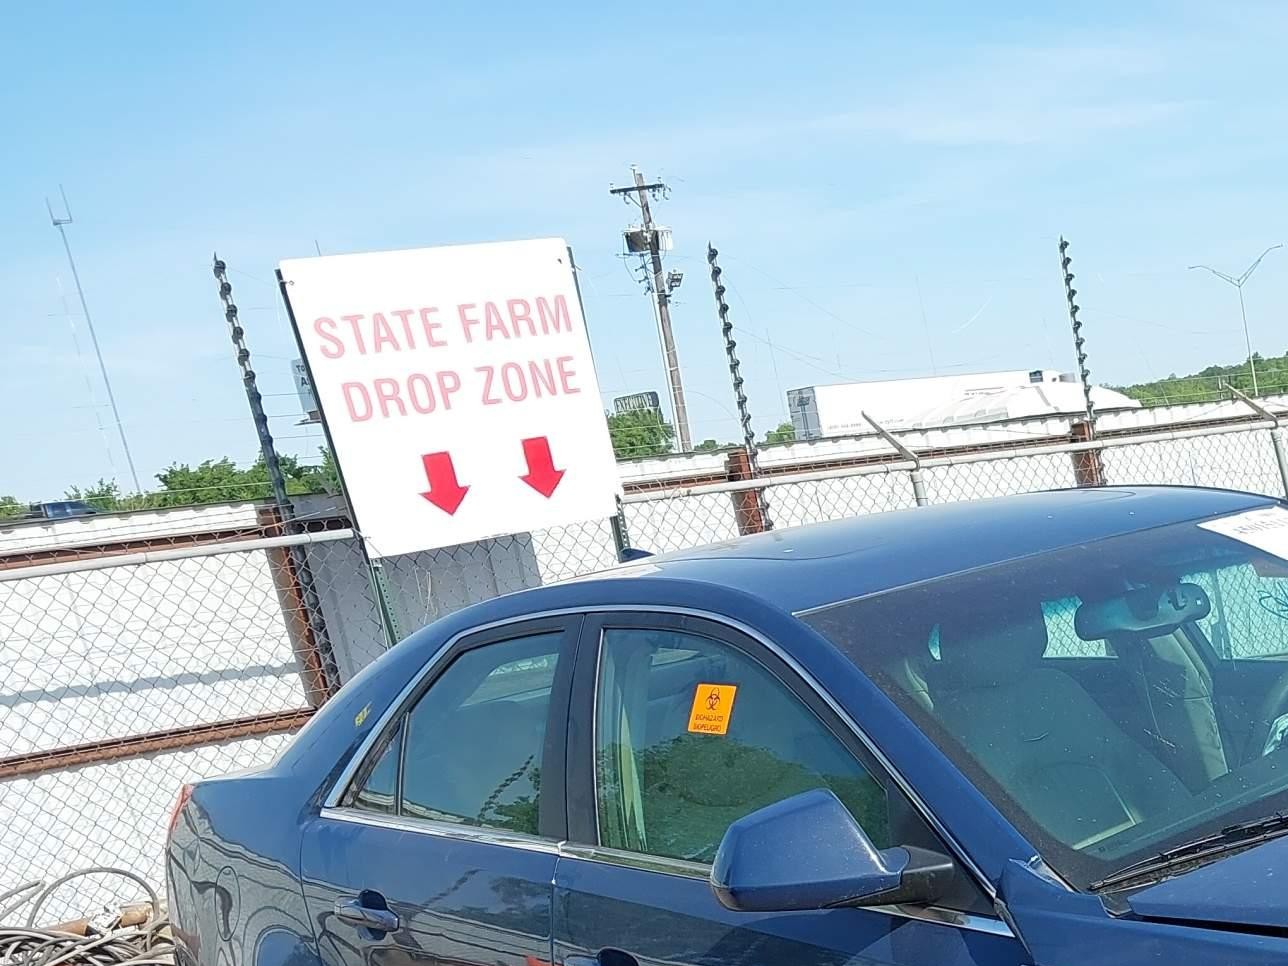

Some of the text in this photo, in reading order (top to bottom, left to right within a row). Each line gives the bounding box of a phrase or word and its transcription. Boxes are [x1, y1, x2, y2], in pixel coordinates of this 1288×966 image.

[313, 294, 573, 359] STATE FARM
[342, 356, 582, 423] DROP ZONE
